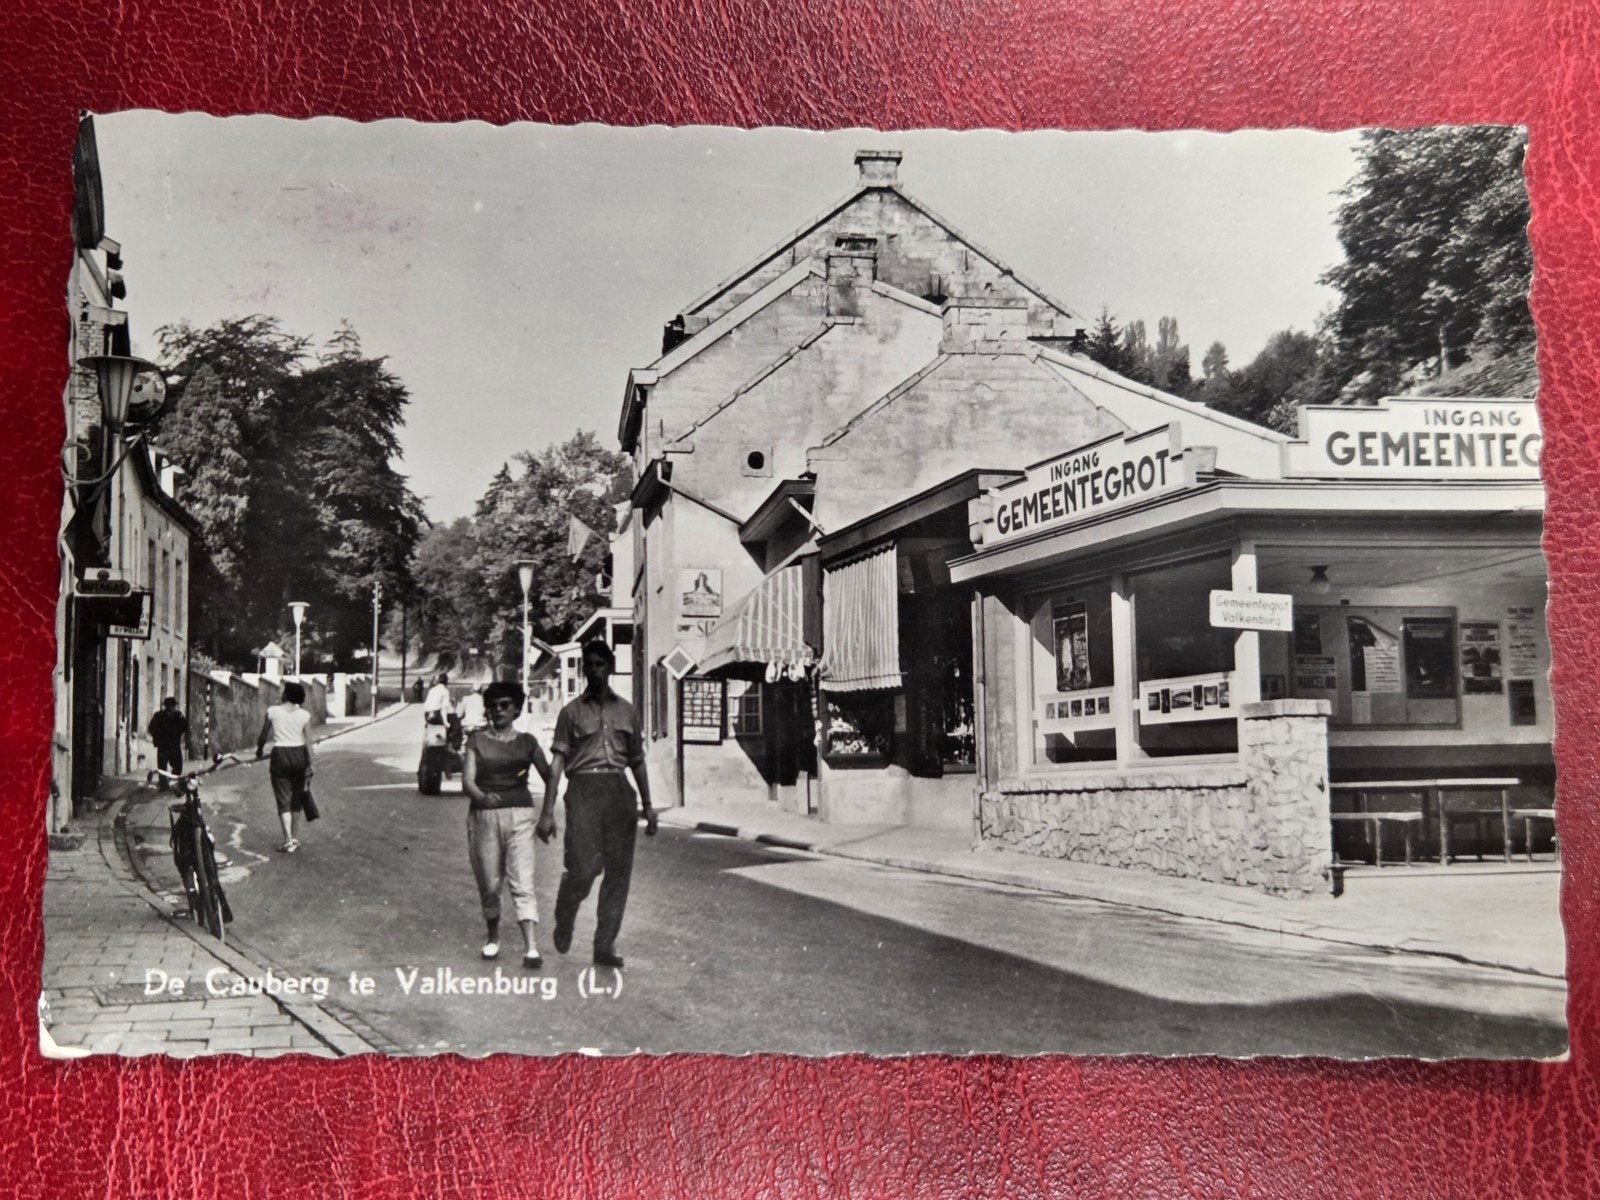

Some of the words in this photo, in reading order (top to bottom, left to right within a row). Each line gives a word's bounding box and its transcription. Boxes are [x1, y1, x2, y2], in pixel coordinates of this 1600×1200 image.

[1424, 409, 1521, 427] INGANG
[1050, 451, 1100, 482] INGANG
[997, 449, 1169, 534] GEMEENTEGROT
[1215, 595, 1288, 615] Gemeentegrot
[1222, 611, 1281, 626] Valkenburg
